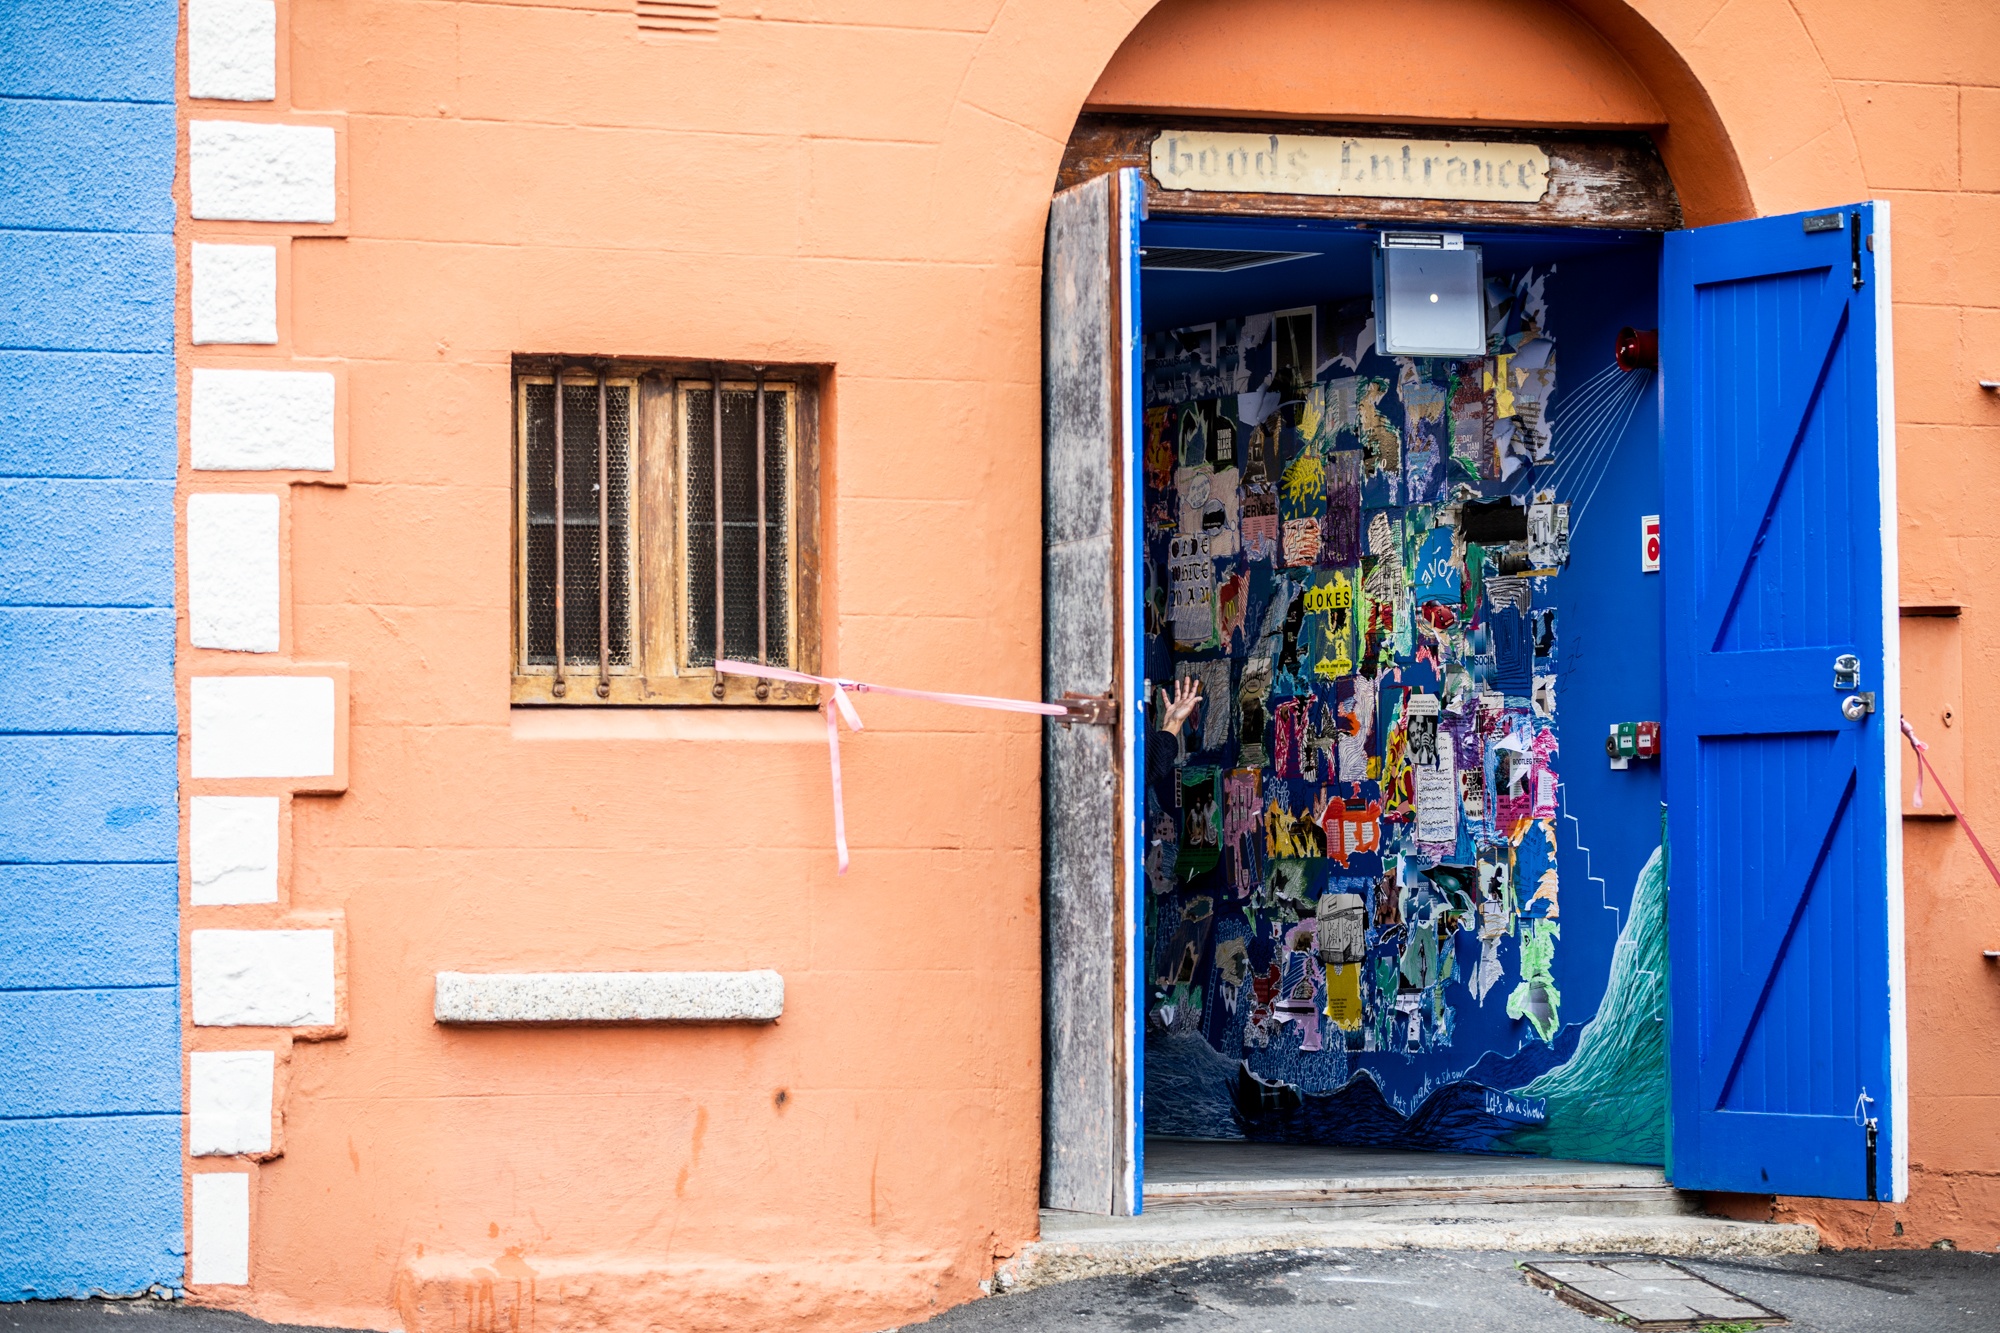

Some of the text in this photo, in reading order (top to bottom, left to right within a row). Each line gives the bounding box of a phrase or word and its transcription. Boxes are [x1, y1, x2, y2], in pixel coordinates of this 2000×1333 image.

[1167, 134, 1538, 189] Goods Entrance
[1307, 591, 1350, 608] JOKES
[1512, 757, 1533, 766] BOOTLEG
[1505, 1097, 1515, 1114] do
[1515, 1103, 1523, 1115] a
